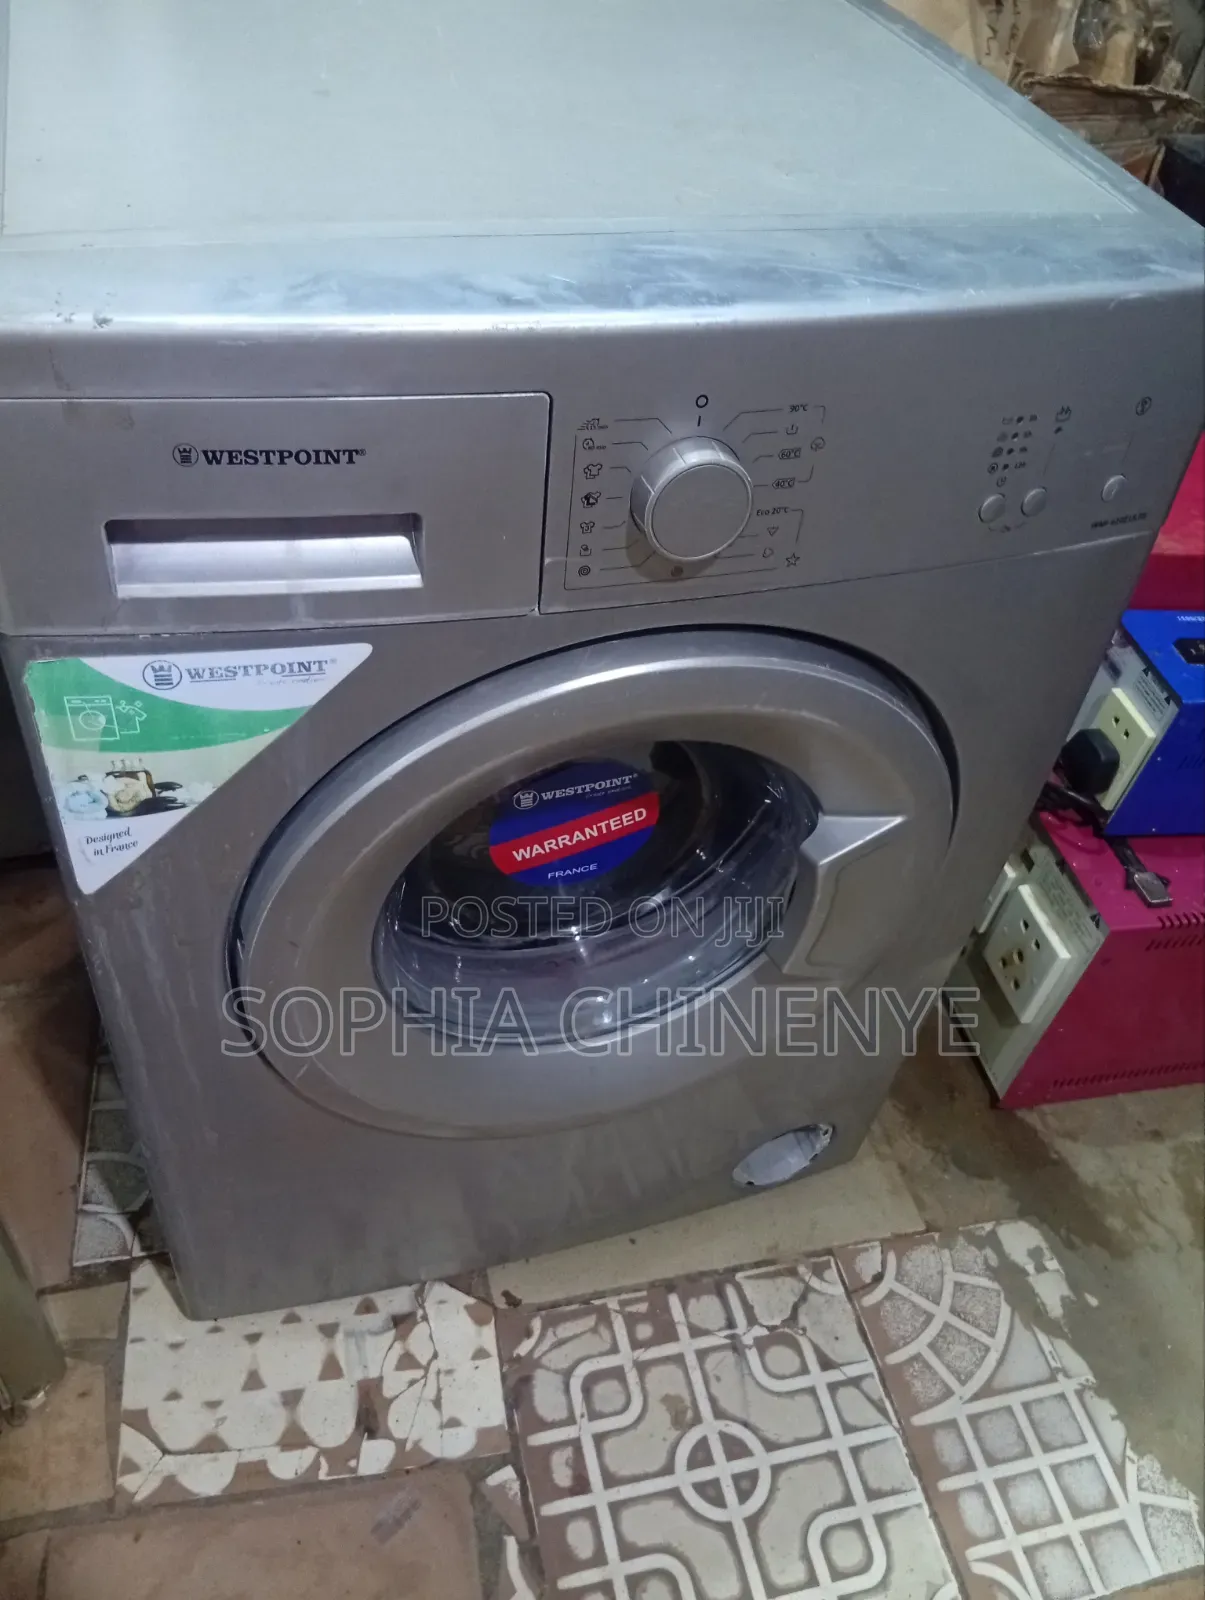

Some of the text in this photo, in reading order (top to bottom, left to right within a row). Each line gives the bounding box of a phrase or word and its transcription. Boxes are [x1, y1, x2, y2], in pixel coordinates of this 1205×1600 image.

[202, 449, 359, 466] WESTPOINT
[756, 509, 770, 517] Eco
[185, 660, 327, 680] WESTPOINT
[541, 775, 632, 801] WESTPOINT
[85, 826, 132, 845] Designed
[512, 807, 647, 862] WARRANTEED
[93, 840, 139, 857] in France
[547, 863, 598, 880] FRANCE
